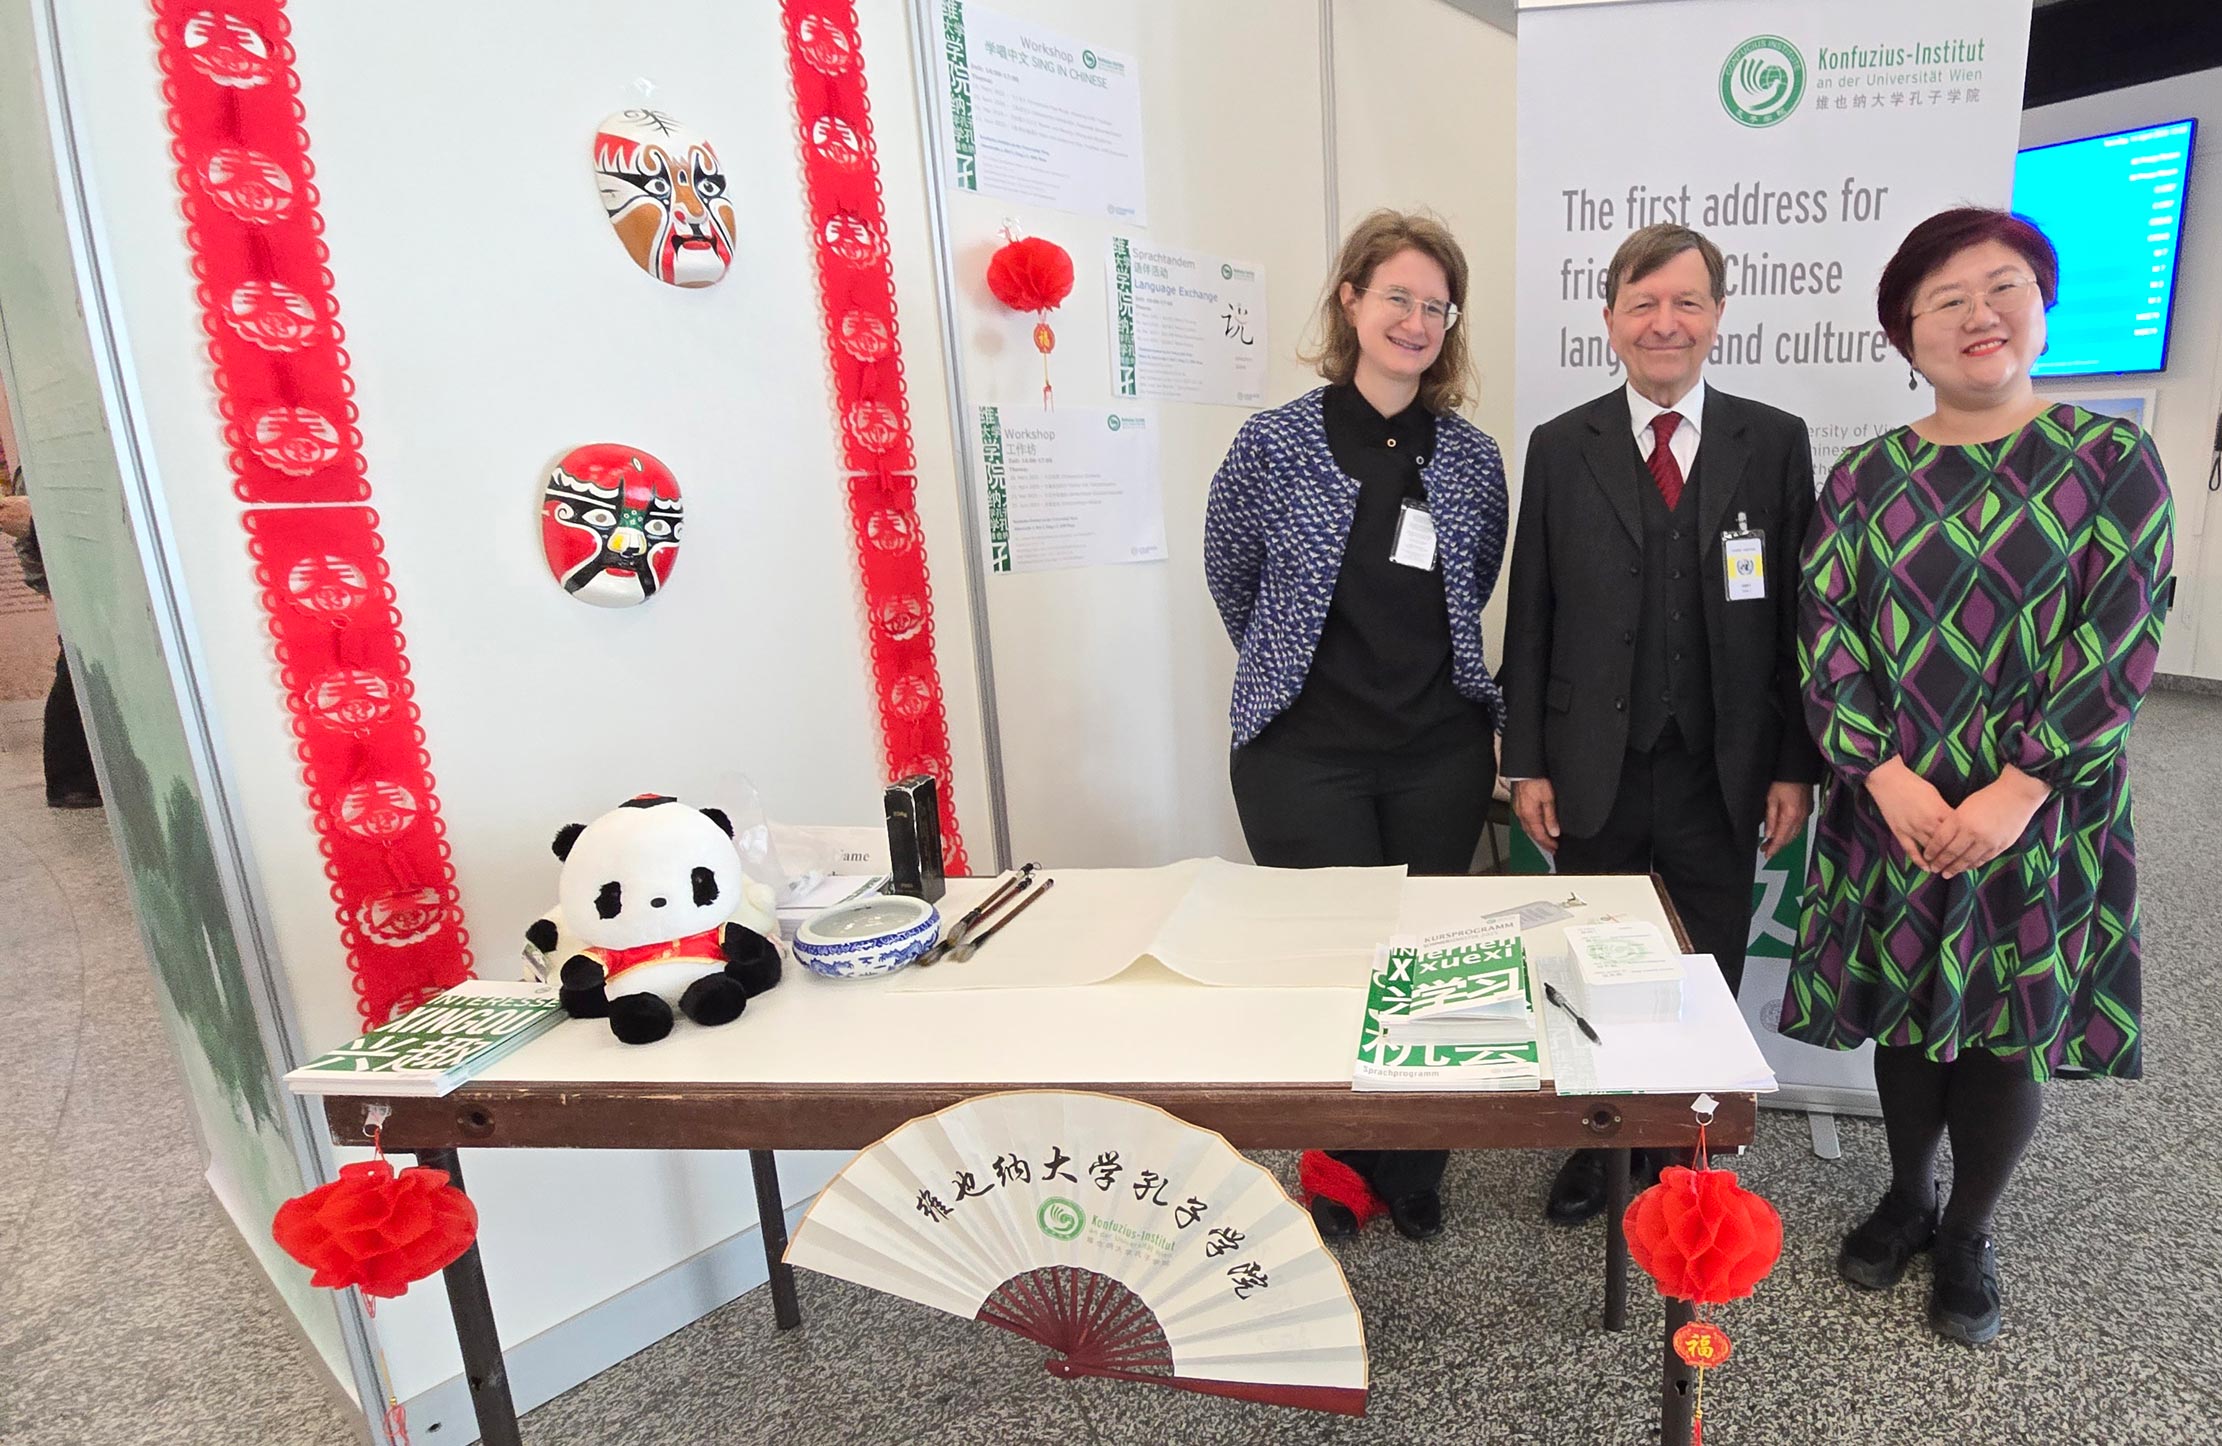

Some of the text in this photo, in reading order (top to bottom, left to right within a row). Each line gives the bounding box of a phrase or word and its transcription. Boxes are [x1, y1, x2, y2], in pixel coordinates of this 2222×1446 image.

[1020, 35, 1074, 64] Workshop
[1818, 38, 1985, 71] Konfuzius-Institut
[1032, 57, 1055, 74] SING
[1057, 63, 1068, 78] IN
[1069, 67, 1109, 89] CHINESE
[1816, 67, 1983, 88] an der Universität Wien
[1816, 87, 1981, 111] 维也纳大学孔子学院
[1562, 177, 1889, 232] The first address for
[1132, 248, 1196, 270] Sprachtandem
[1560, 252, 1843, 300] frie Chinese
[1134, 279, 1218, 303] Language Exchange
[1560, 321, 1888, 377] lang and culture
[1004, 428, 1056, 441] Workshop
[1809, 424, 1849, 440] ersity
[1853, 424, 1868, 437] of
[841, 850, 870, 862] ame
[1424, 922, 1514, 943] KURSPROGRAMM
[1419, 944, 1512, 974] xuexi
[426, 994, 559, 1008] INTERESSE
[1363, 1065, 1440, 1078] Sprachprogramm
[1091, 1215, 1176, 1251] Konfuzius-Institut
[1685, 1333, 1714, 1358] 福
